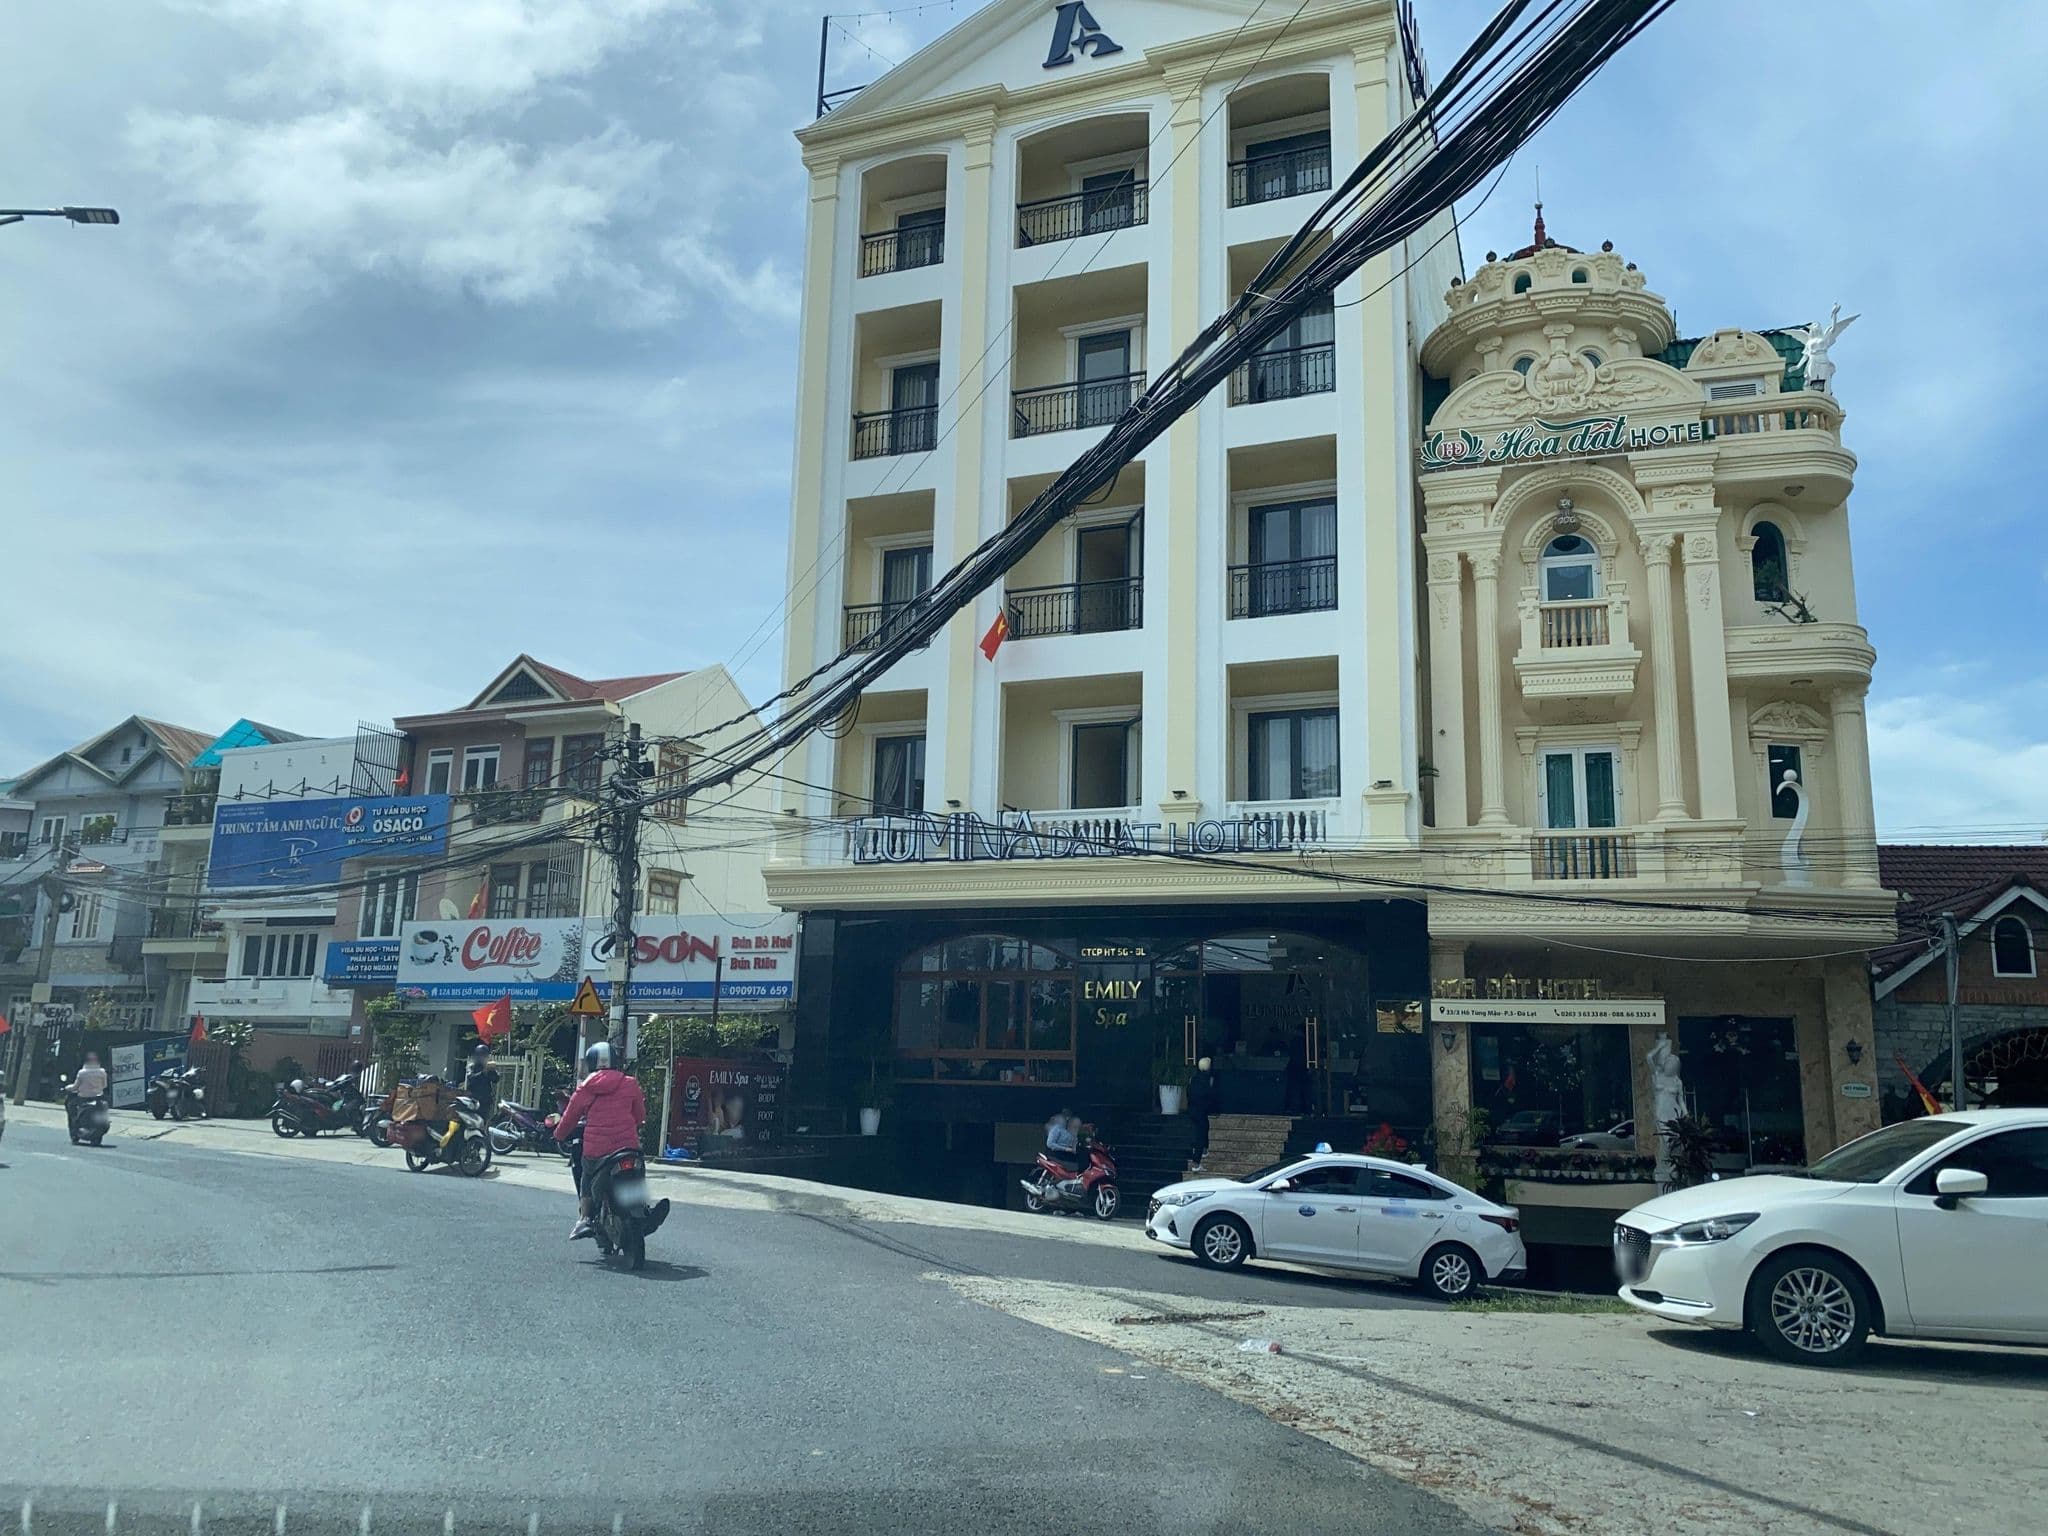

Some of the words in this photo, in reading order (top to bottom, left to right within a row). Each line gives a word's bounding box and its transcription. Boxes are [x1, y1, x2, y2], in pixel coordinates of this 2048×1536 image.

[1630, 419, 1716, 448] HOTEL
[1490, 424, 1562, 462] Hoa
[400, 806, 410, 814] DU
[411, 805, 427, 815] HỌC
[220, 822, 255, 835] TRUNG
[256, 818, 279, 832] TÂM
[280, 819, 303, 831] ANH
[330, 817, 342, 828] IC
[854, 810, 1043, 864] LUMINA
[1168, 819, 1292, 853] HOTEL
[462, 926, 541, 971] Coffee
[636, 931, 719, 964] SƠN
[731, 936, 752, 949] Bún
[755, 936, 768, 949] Bò
[1081, 948, 1103, 957] CTCP
[1104, 948, 1115, 956] HT
[1117, 947, 1129, 956] SG
[730, 957, 751, 970] Bún
[638, 986, 662, 996] TÙNG
[662, 986, 683, 997] MẬU
[729, 986, 767, 995] 0909176
[770, 986, 788, 995] 659
[1084, 980, 1142, 1000] EMILY
[1537, 979, 1610, 1000] HOTEL
[1095, 1007, 1128, 1029] Spa
[1471, 1009, 1487, 1017] Tùng
[709, 1070, 733, 1084] EMILY
[734, 1071, 749, 1086] Spa
[758, 1093, 776, 1103] BODY
[758, 1111, 774, 1121] FOOT
